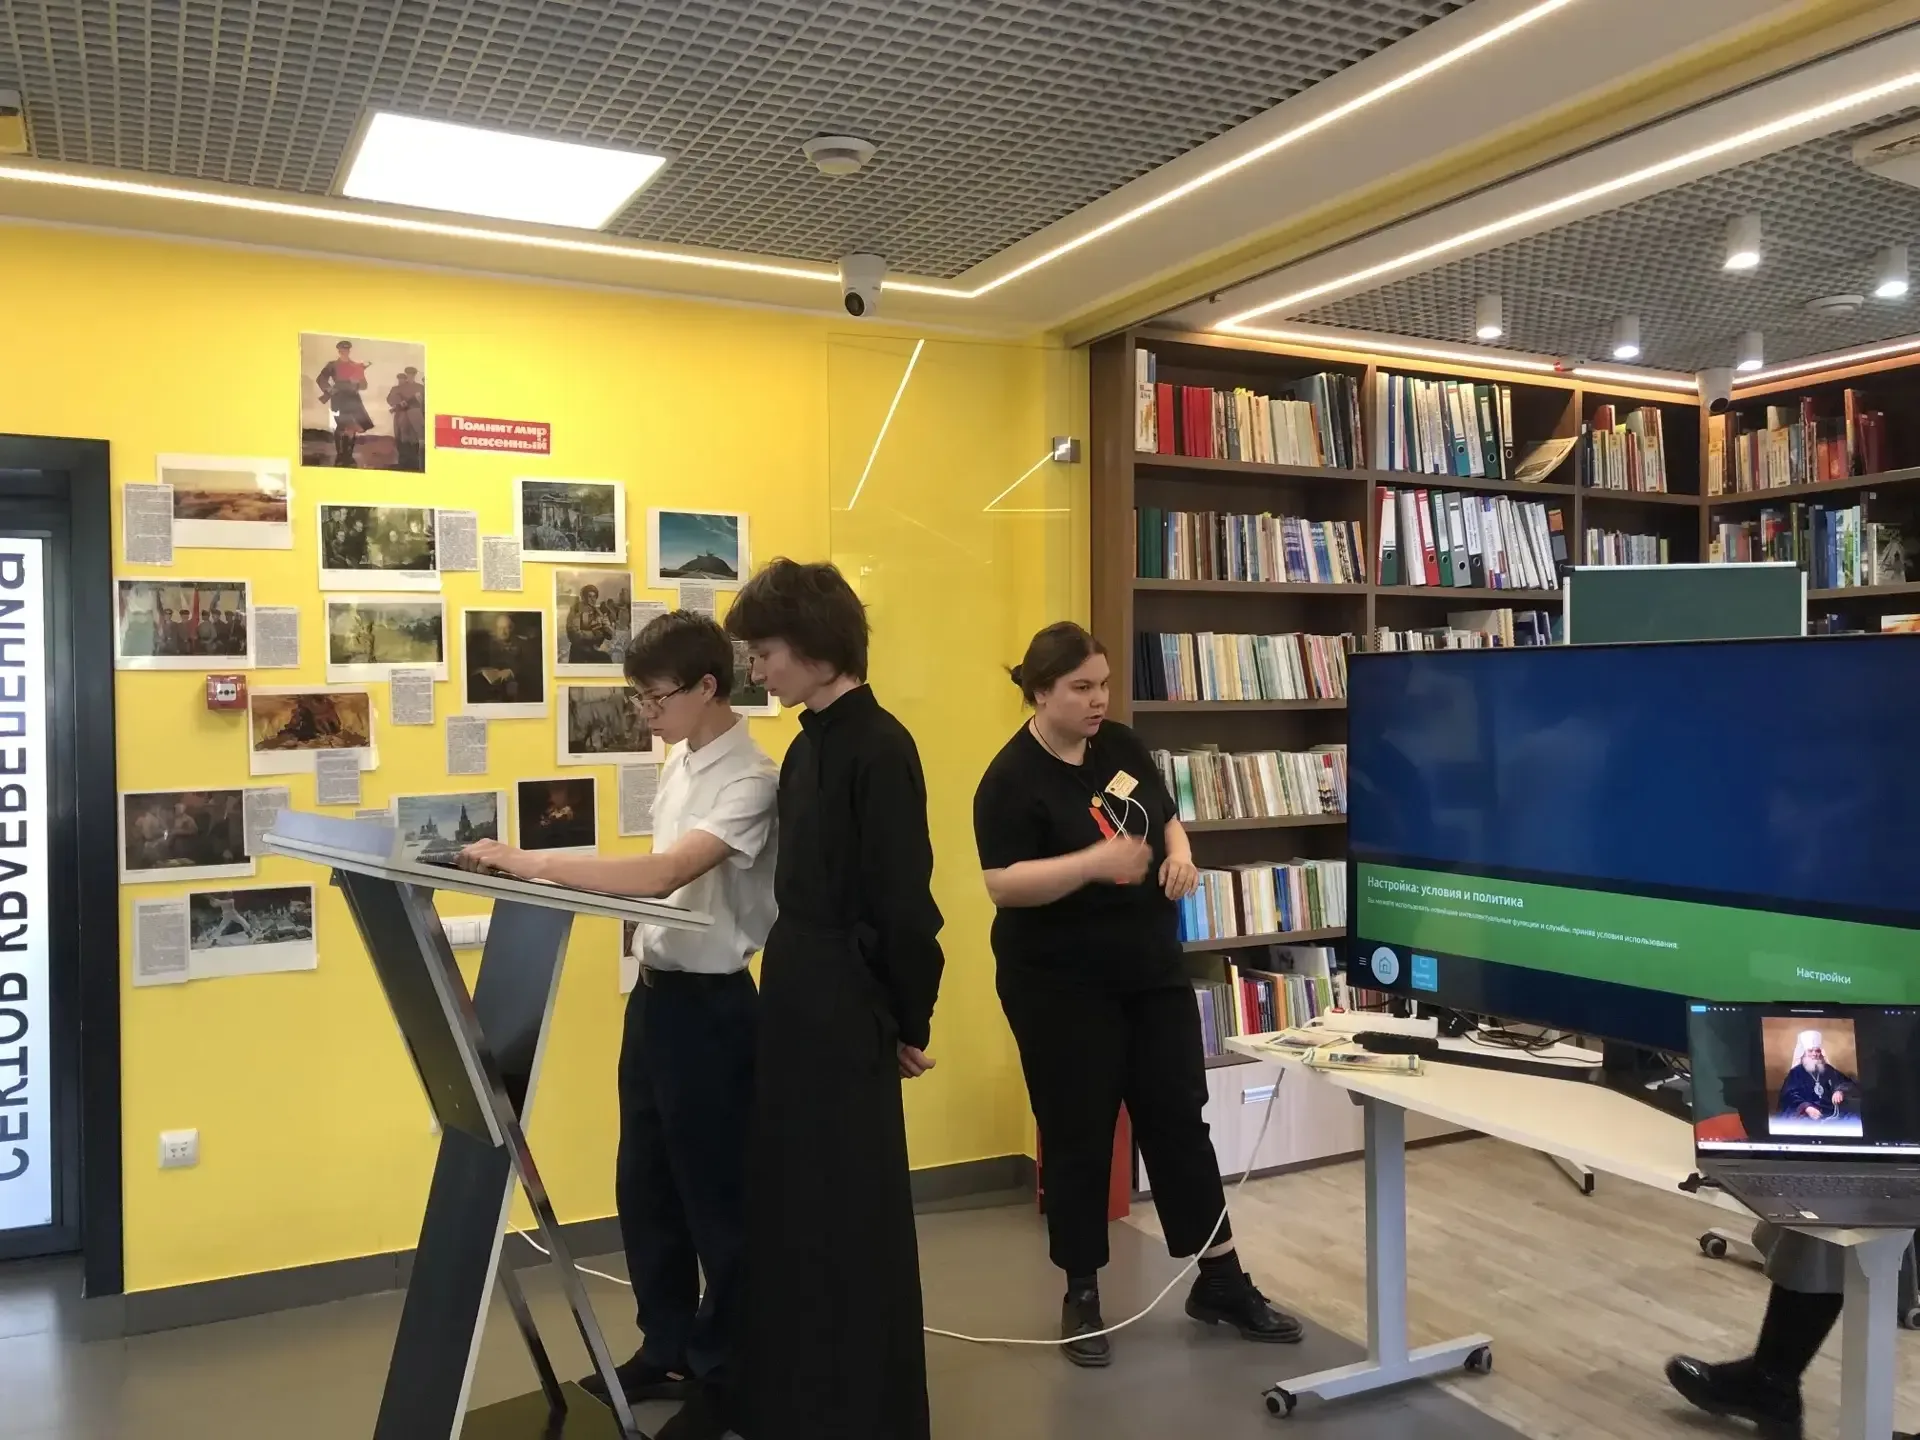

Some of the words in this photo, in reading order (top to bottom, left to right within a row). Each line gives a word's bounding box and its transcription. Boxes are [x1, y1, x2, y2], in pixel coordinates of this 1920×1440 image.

[451, 416, 513, 434] Помнит
[514, 425, 547, 439] мир
[460, 436, 548, 450] спасенный
[1367, 876, 1420, 893] Настройка:
[1421, 884, 1462, 899] условия
[1463, 891, 1471, 899] и
[1472, 892, 1524, 908] политика
[1572, 927, 1596, 937] приняв
[1596, 930, 1624, 941] условия
[1796, 966, 1852, 985] Настройки
